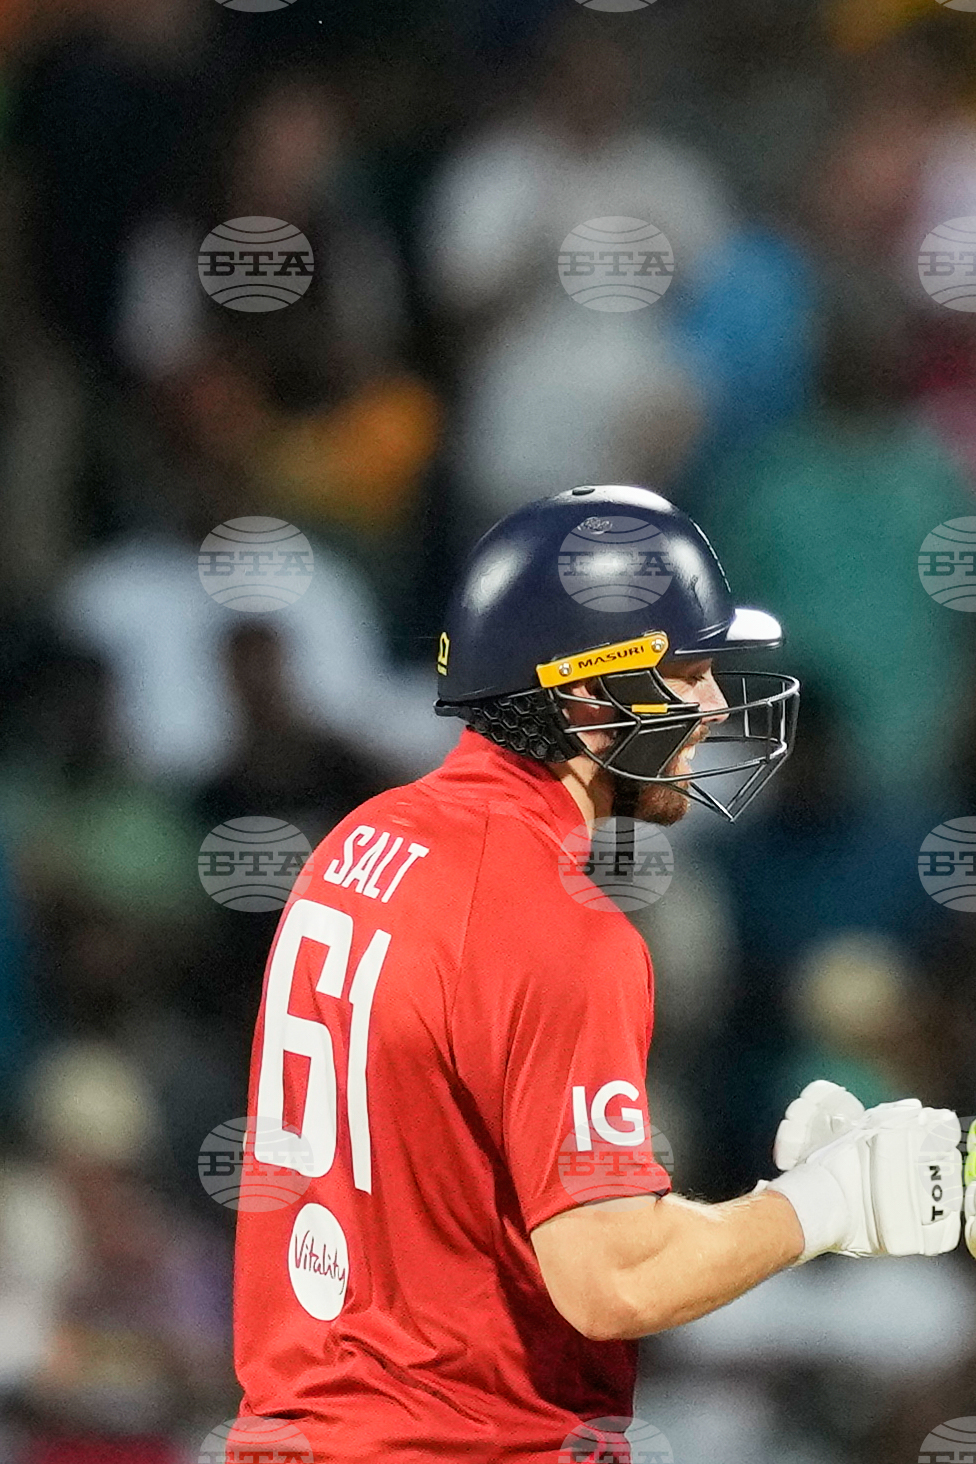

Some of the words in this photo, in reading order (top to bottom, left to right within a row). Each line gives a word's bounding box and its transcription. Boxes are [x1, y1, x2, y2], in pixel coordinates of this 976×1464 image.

[578, 645, 645, 669] MASURI
[323, 825, 430, 903] SALT
[254, 898, 391, 1195] 61
[572, 1080, 645, 1151] IG
[930, 1165, 943, 1221] TON
[295, 1230, 346, 1295] Vitality
